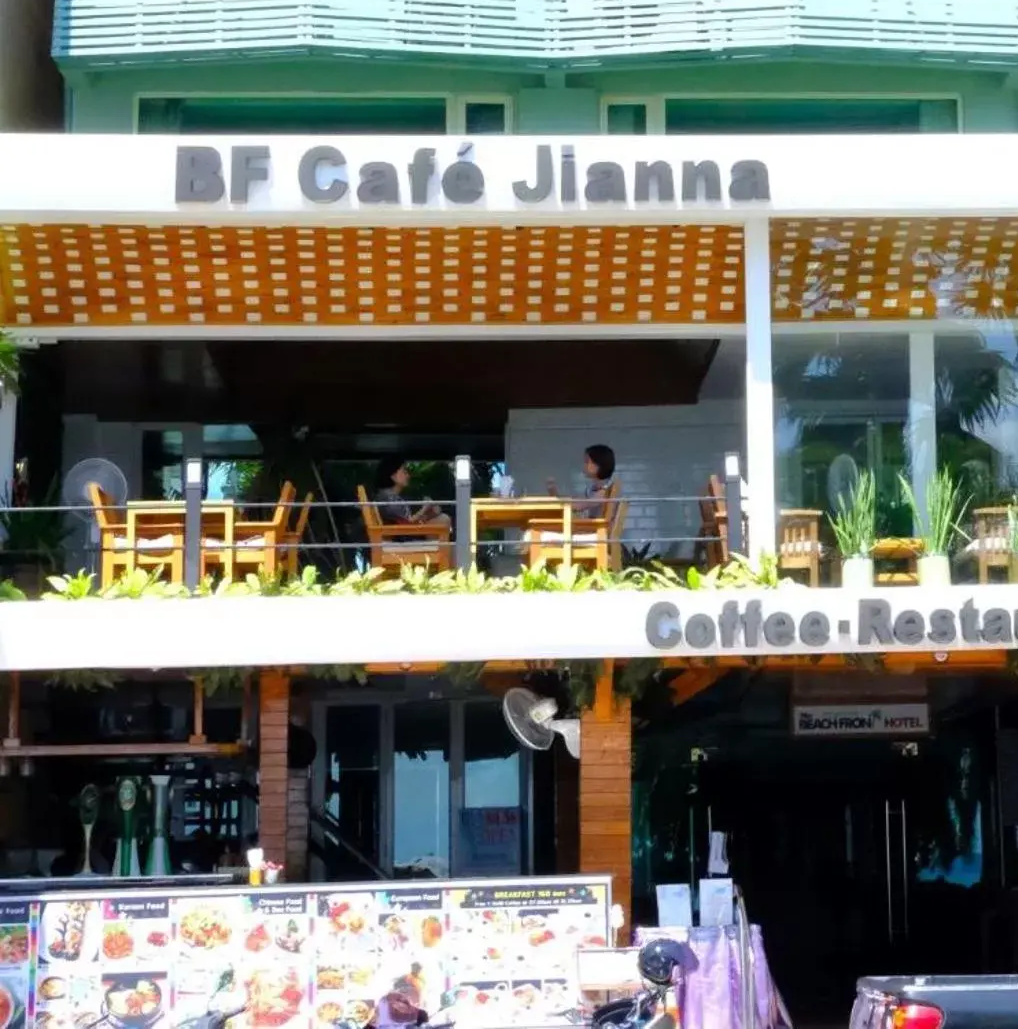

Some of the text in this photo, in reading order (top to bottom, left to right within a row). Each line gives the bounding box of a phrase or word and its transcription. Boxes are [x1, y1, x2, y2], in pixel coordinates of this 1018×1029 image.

[175, 142, 771, 204] BF Café Jianna
[645, 599, 830, 649] Coffee
[799, 717, 837, 729] BEACH
[884, 716, 924, 729] HOTEL
